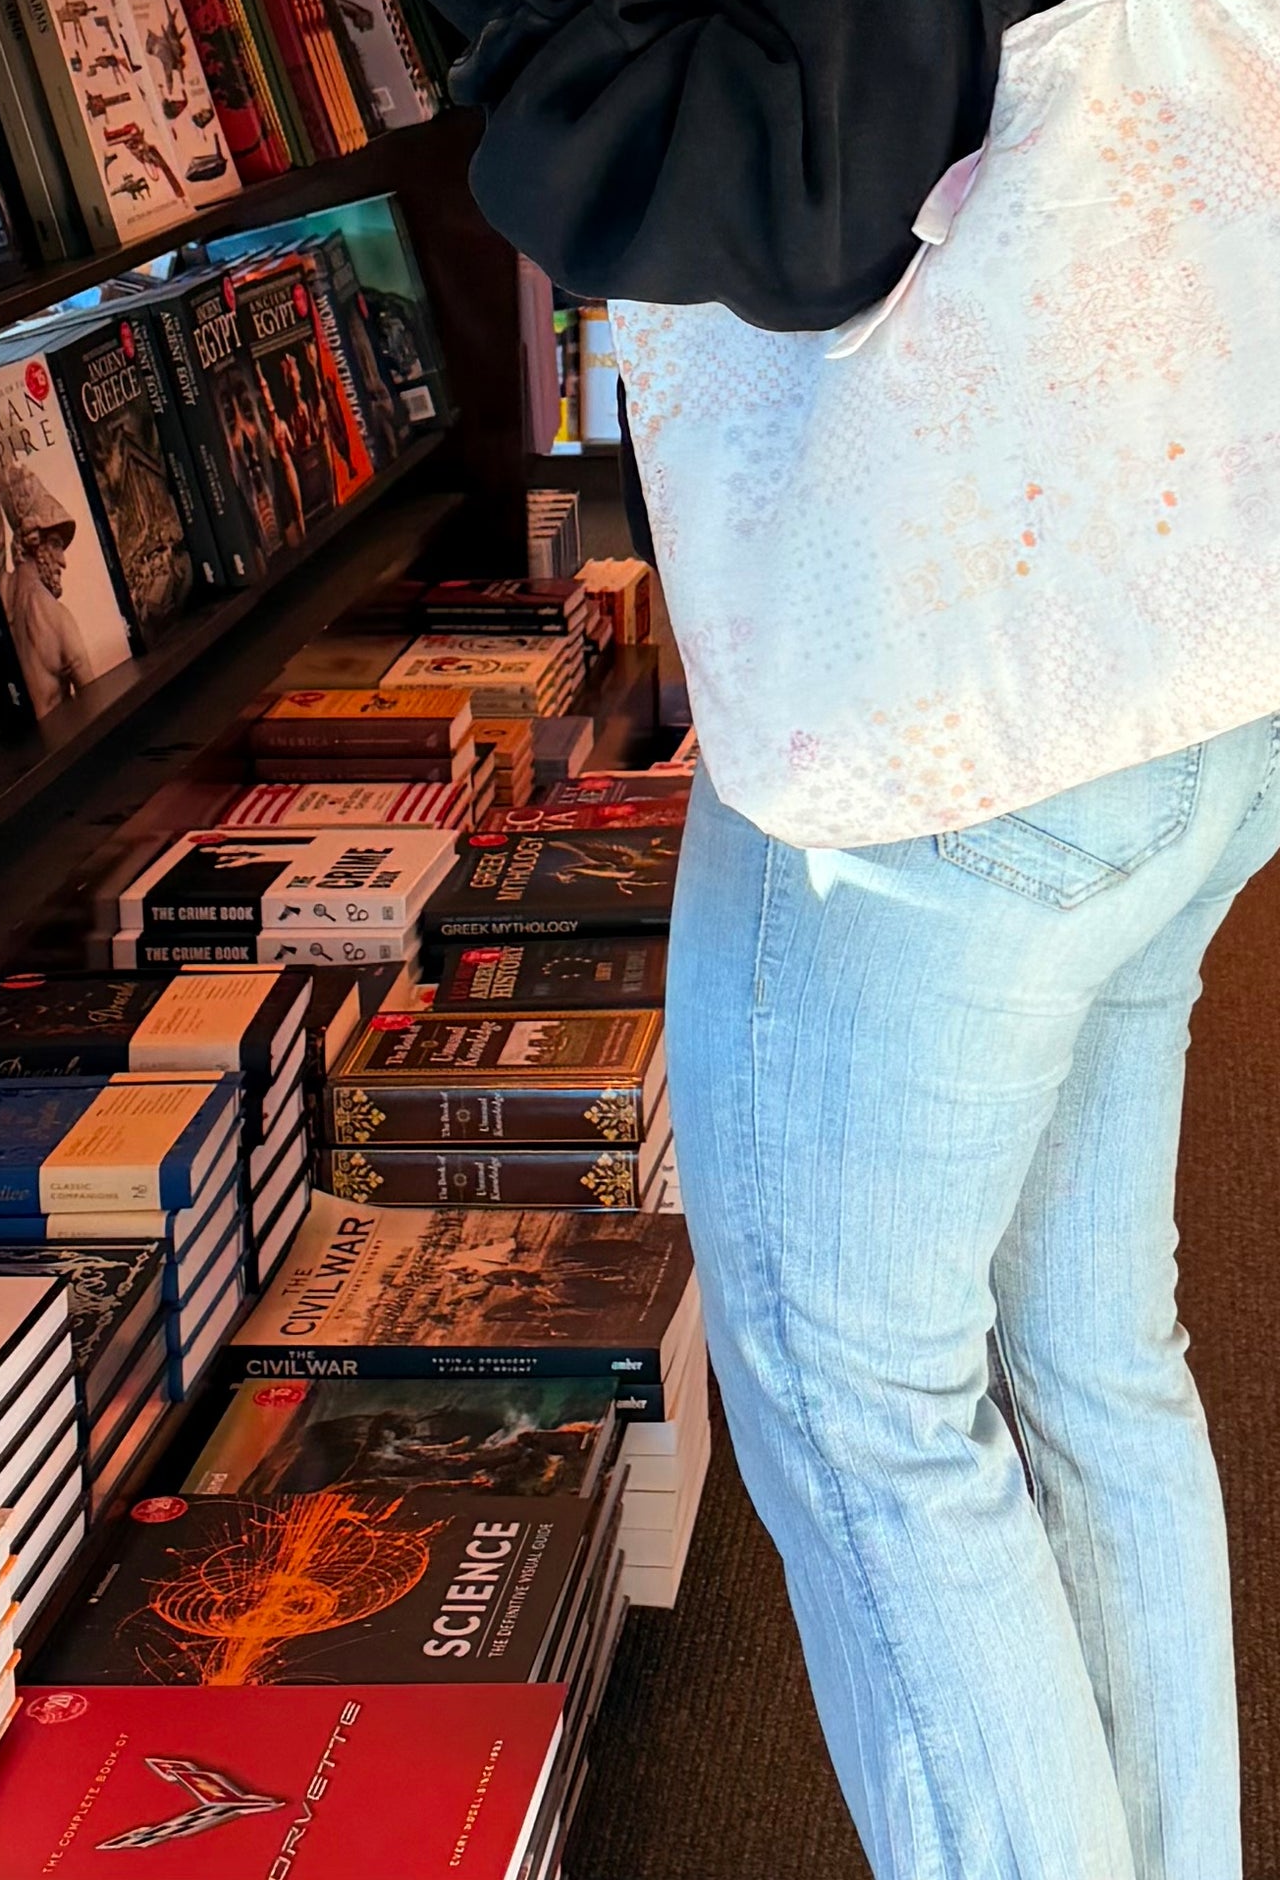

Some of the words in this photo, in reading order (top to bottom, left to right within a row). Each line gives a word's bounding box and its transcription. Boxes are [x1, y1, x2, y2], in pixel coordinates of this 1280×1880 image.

[250, 289, 292, 313] ANCIENT
[253, 299, 296, 338] EGYPT
[194, 313, 243, 369] EGYPT
[88, 348, 128, 384] ANCIENT
[81, 362, 142, 422] GREECE
[316, 846, 394, 889] CRIME
[471, 852, 508, 889] GREEK
[151, 907, 174, 921] THE
[178, 907, 220, 921] CRIME
[224, 906, 254, 921] BOOK
[441, 923, 489, 936] GREEK
[491, 921, 578, 935] MYTHOLOGY
[280, 1274, 331, 1336] CIVIL
[320, 1217, 376, 1278] WAR
[246, 1360, 310, 1376] CIVIL
[312, 1360, 358, 1375] WAR
[422, 1522, 520, 1659] SCIENCE
[488, 1639, 504, 1659] THE
[496, 1586, 526, 1639] DEFINITIVE
[519, 1552, 539, 1590] VISUAL
[531, 1522, 554, 1555] GUIDE
[42, 1847, 64, 1875] THE
[59, 1786, 102, 1848] COMPLETE
[96, 1751, 118, 1785] BOOK
[115, 1732, 129, 1751] OF
[267, 1700, 361, 1880] ORVETTE
